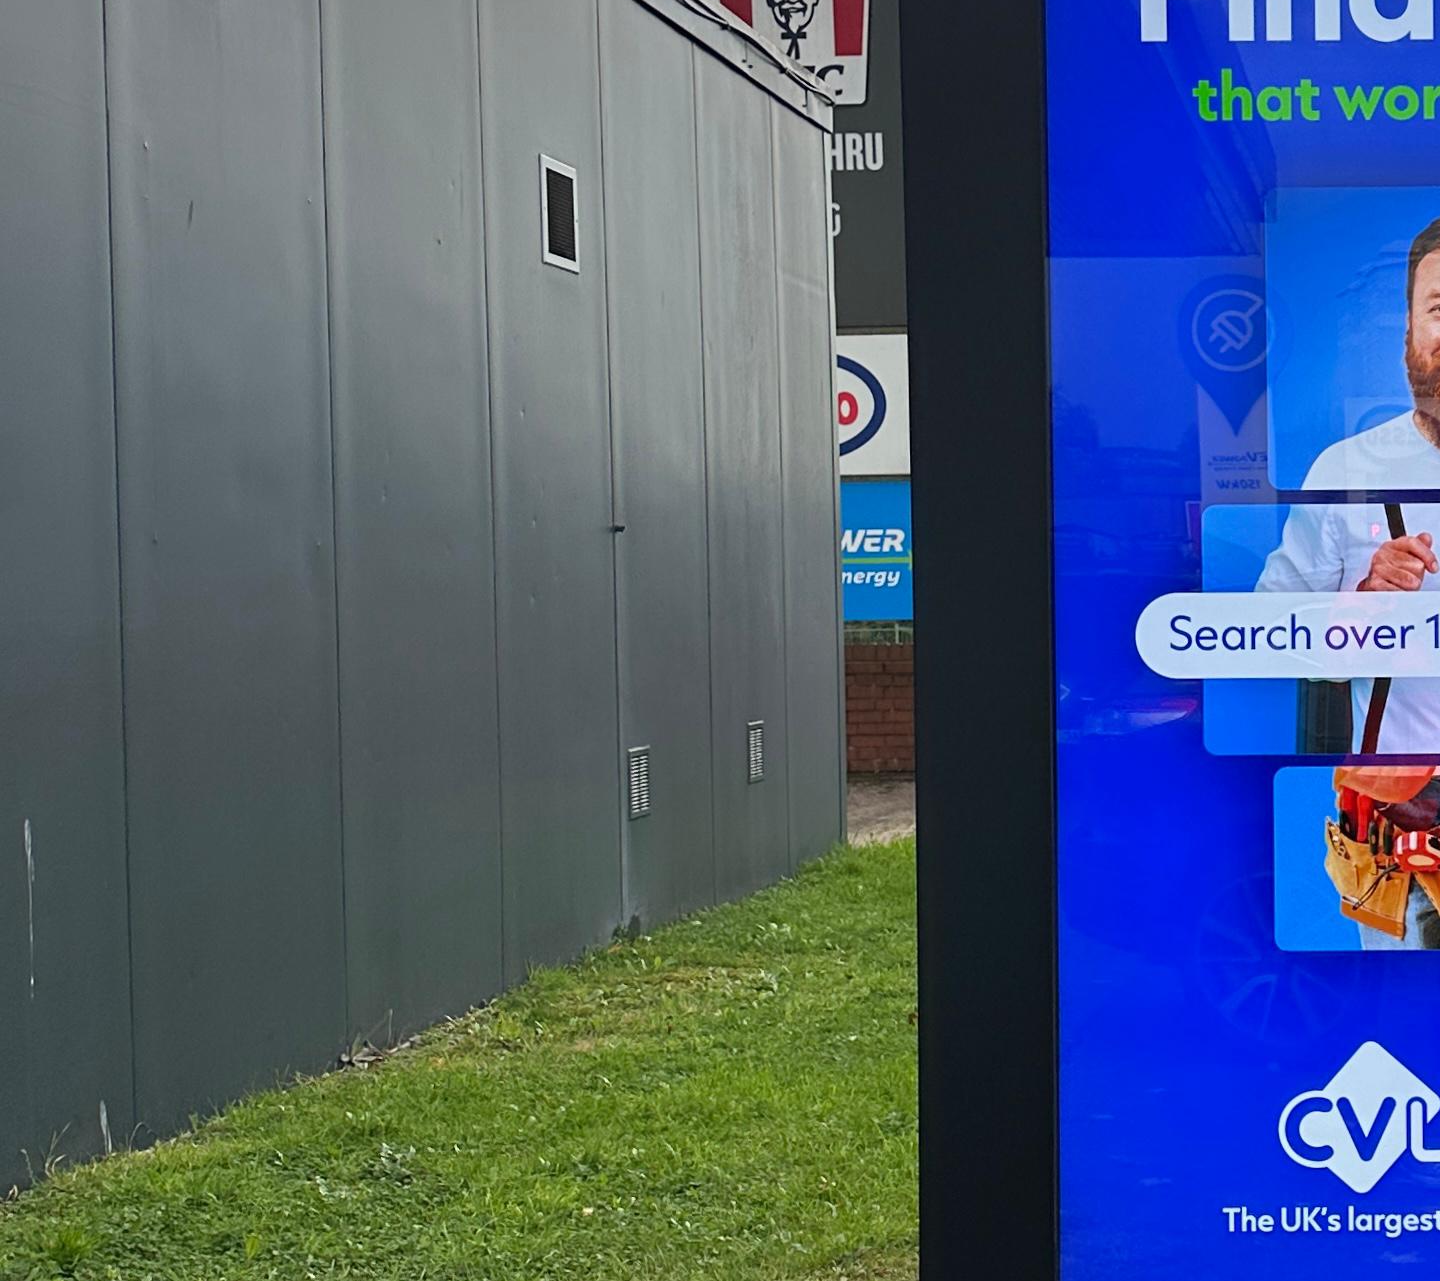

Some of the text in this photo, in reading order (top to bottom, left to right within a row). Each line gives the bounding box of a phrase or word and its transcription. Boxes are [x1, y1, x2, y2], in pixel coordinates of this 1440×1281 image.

[1192, 69, 1320, 122] that
[1168, 612, 1313, 653] Search
[1323, 623, 1416, 652] over
[1221, 1205, 1276, 1233] The
[1280, 1205, 1342, 1233] UK's
